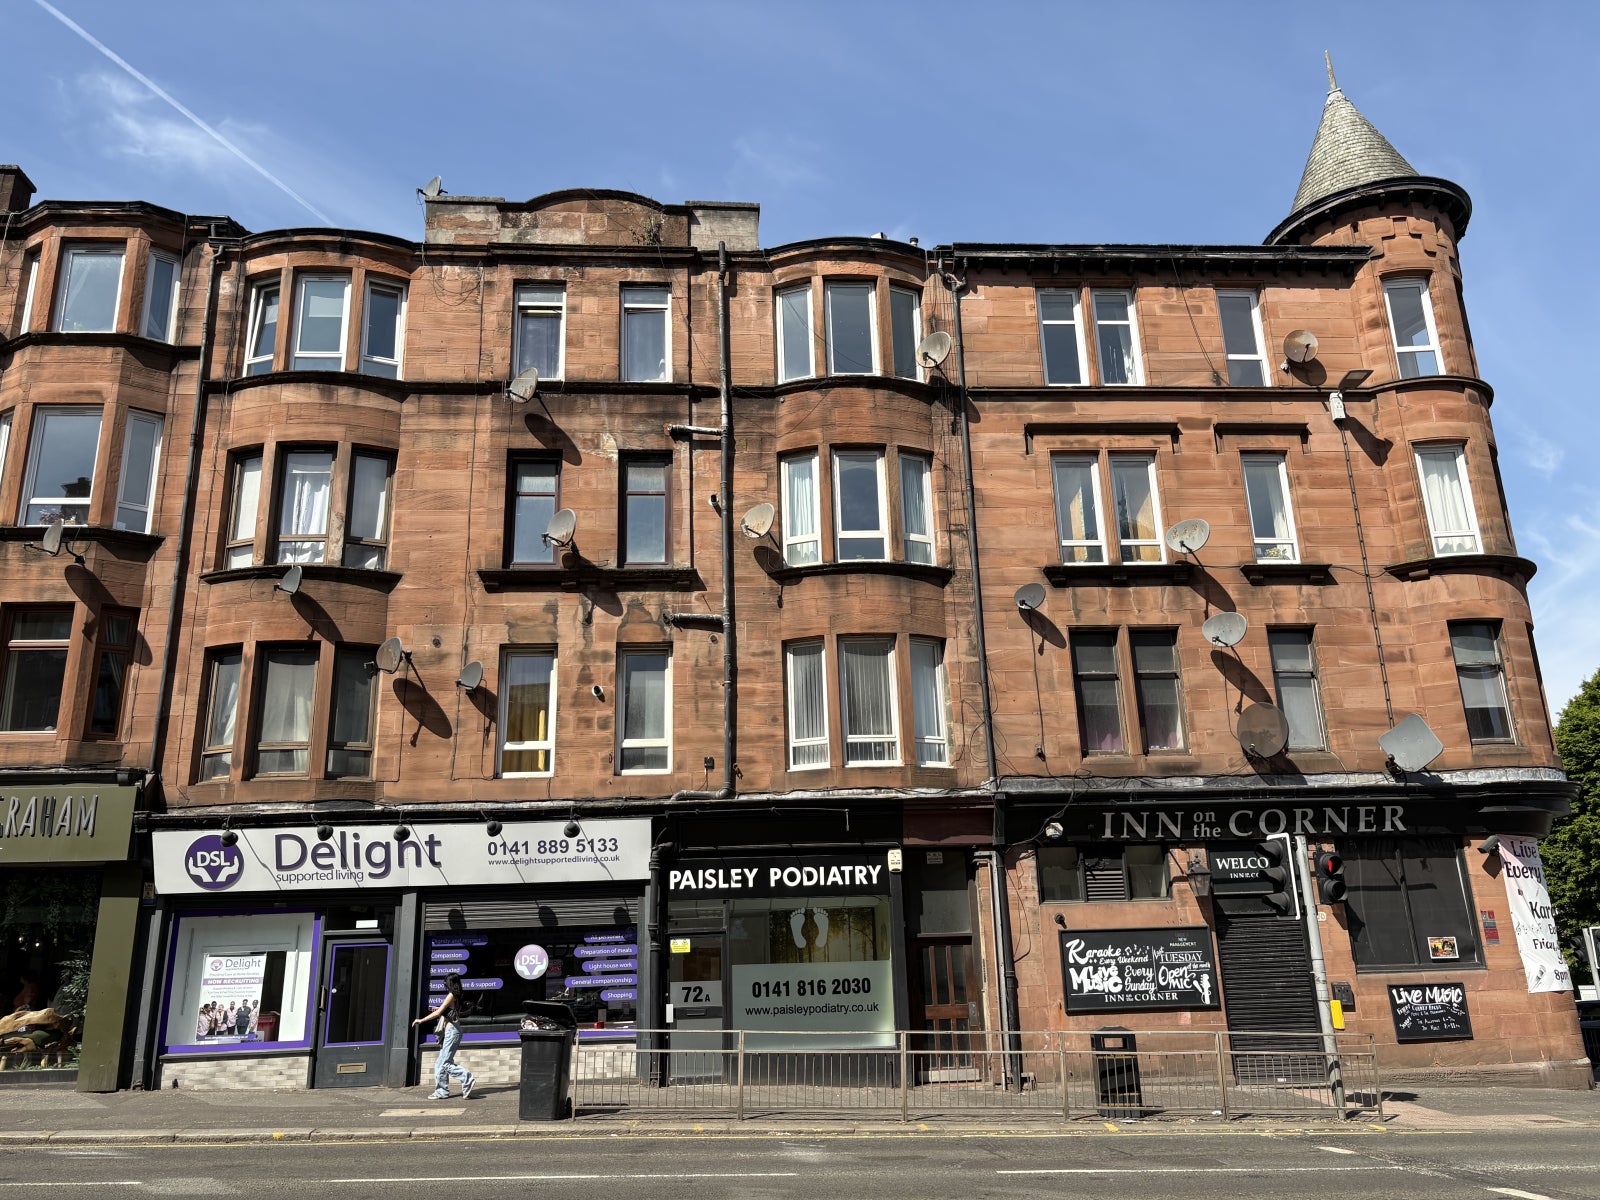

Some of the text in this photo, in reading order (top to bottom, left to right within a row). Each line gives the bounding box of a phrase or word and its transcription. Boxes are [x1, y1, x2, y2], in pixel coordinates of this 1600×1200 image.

[1101, 805, 1407, 839] INN on the CORNER
[487, 837, 619, 856] 0141 889 5133
[1510, 840, 1537, 858] Live
[196, 850, 231, 867] DSL
[275, 831, 442, 880] Delight
[488, 855, 620, 866] www.delightsupportedliving.co.uk
[1216, 856, 1269, 870] WELCO
[276, 869, 364, 884] supported living
[669, 864, 882, 890] PAISLEY PODIATRY
[1504, 861, 1542, 883] Every
[431, 952, 463, 960] Compassion
[1065, 938, 1121, 965] Karaoke
[1117, 955, 1149, 964] Weekend
[1160, 953, 1203, 962] TUESDAY
[225, 958, 261, 969] Delight
[521, 955, 541, 965] DSL
[223, 977, 260, 985] RECRUITING
[1124, 965, 1154, 982] Every
[1158, 965, 1191, 986] Open
[475, 981, 497, 989] support
[751, 977, 871, 998] 0141 816 2030
[1124, 977, 1157, 994] Sunday
[1169, 978, 1192, 989] MIC
[1104, 994, 1125, 1002] INN
[1134, 992, 1179, 1001] CORNER
[1391, 986, 1463, 1004] Live Music
[745, 1001, 879, 1016] www.paisleypodiatry.co.uk
